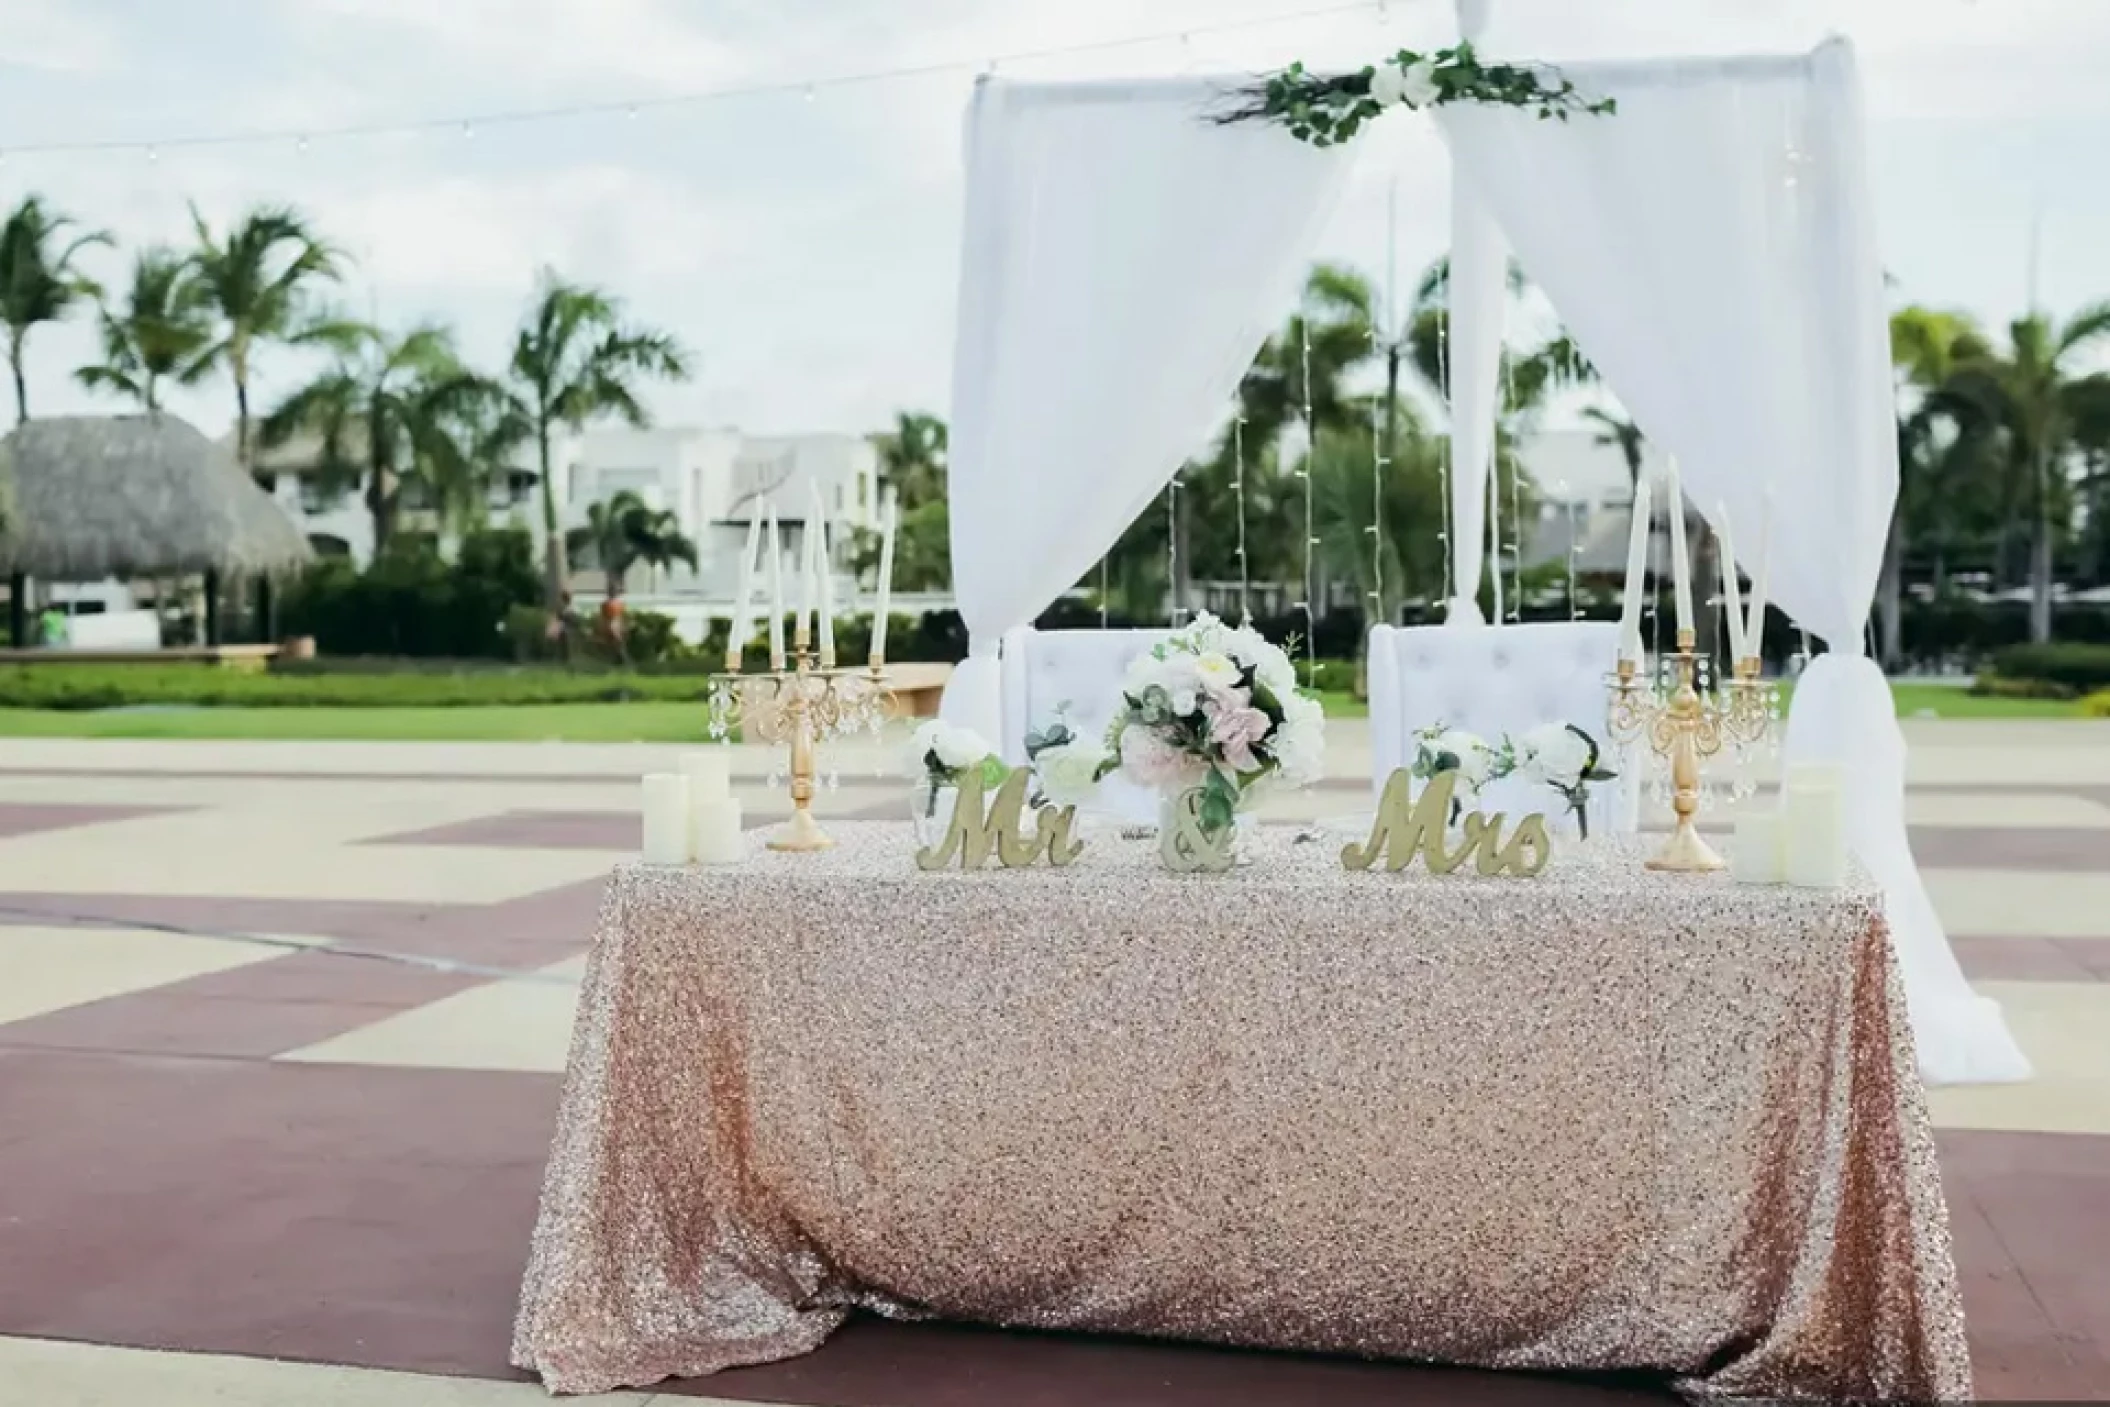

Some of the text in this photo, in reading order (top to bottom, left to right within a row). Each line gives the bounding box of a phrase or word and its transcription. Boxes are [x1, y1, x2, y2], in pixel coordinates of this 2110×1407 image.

[916, 767, 1550, 877] Mr & Mrs
